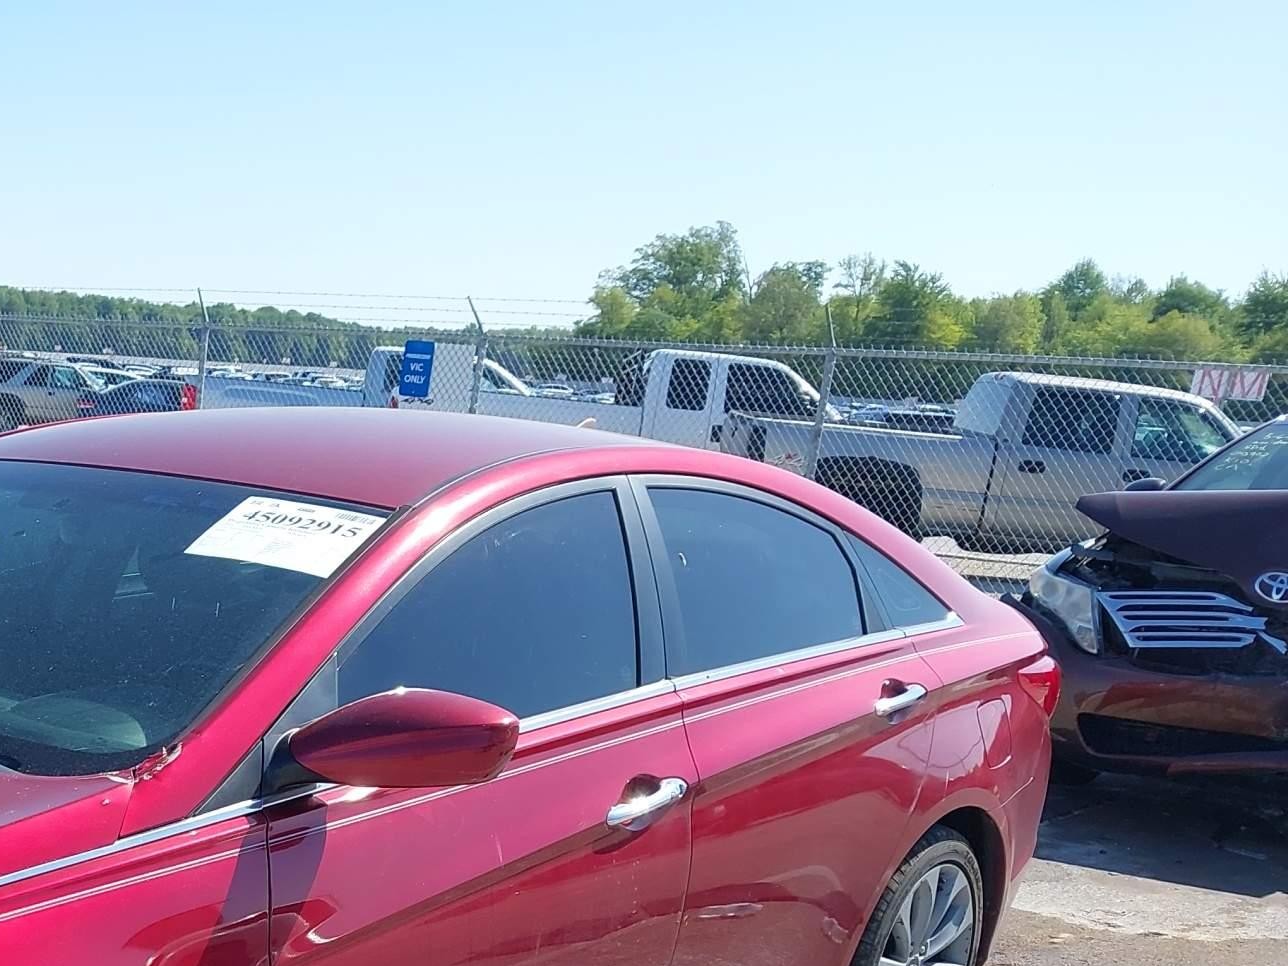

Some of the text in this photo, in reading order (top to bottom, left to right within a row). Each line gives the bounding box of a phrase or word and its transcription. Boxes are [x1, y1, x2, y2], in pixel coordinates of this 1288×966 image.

[410, 363, 424, 372] VIC
[404, 375, 426, 384] ONLY
[243, 510, 362, 538] 45092915
